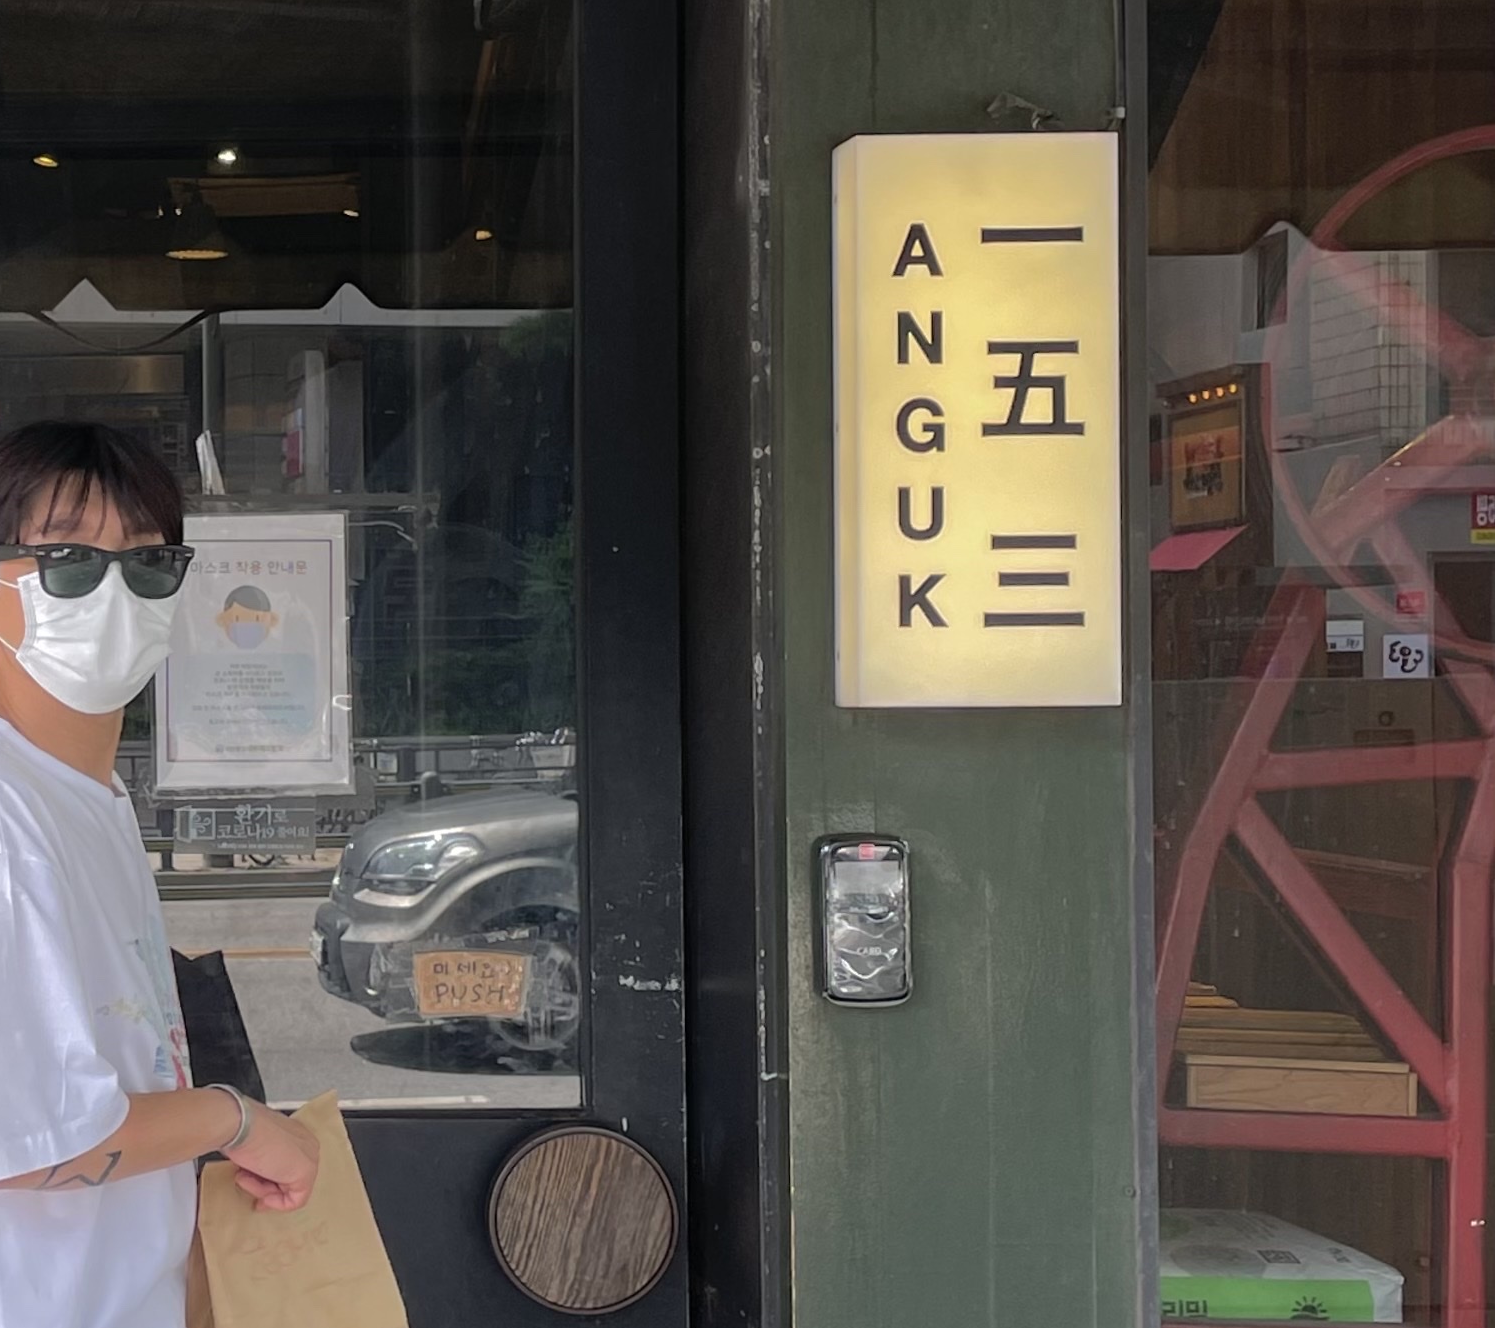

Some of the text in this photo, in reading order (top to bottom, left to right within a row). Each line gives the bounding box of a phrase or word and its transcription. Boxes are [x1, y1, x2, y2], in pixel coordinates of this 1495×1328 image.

[892, 222, 948, 629] ANGUK
[980, 225, 1086, 628] 一五三
[235, 560, 262, 575] 착용
[267, 560, 308, 576] 안내문
[234, 803, 289, 825] 환기로
[216, 823, 275, 841] 코로나19
[435, 982, 505, 1005] PUSH
